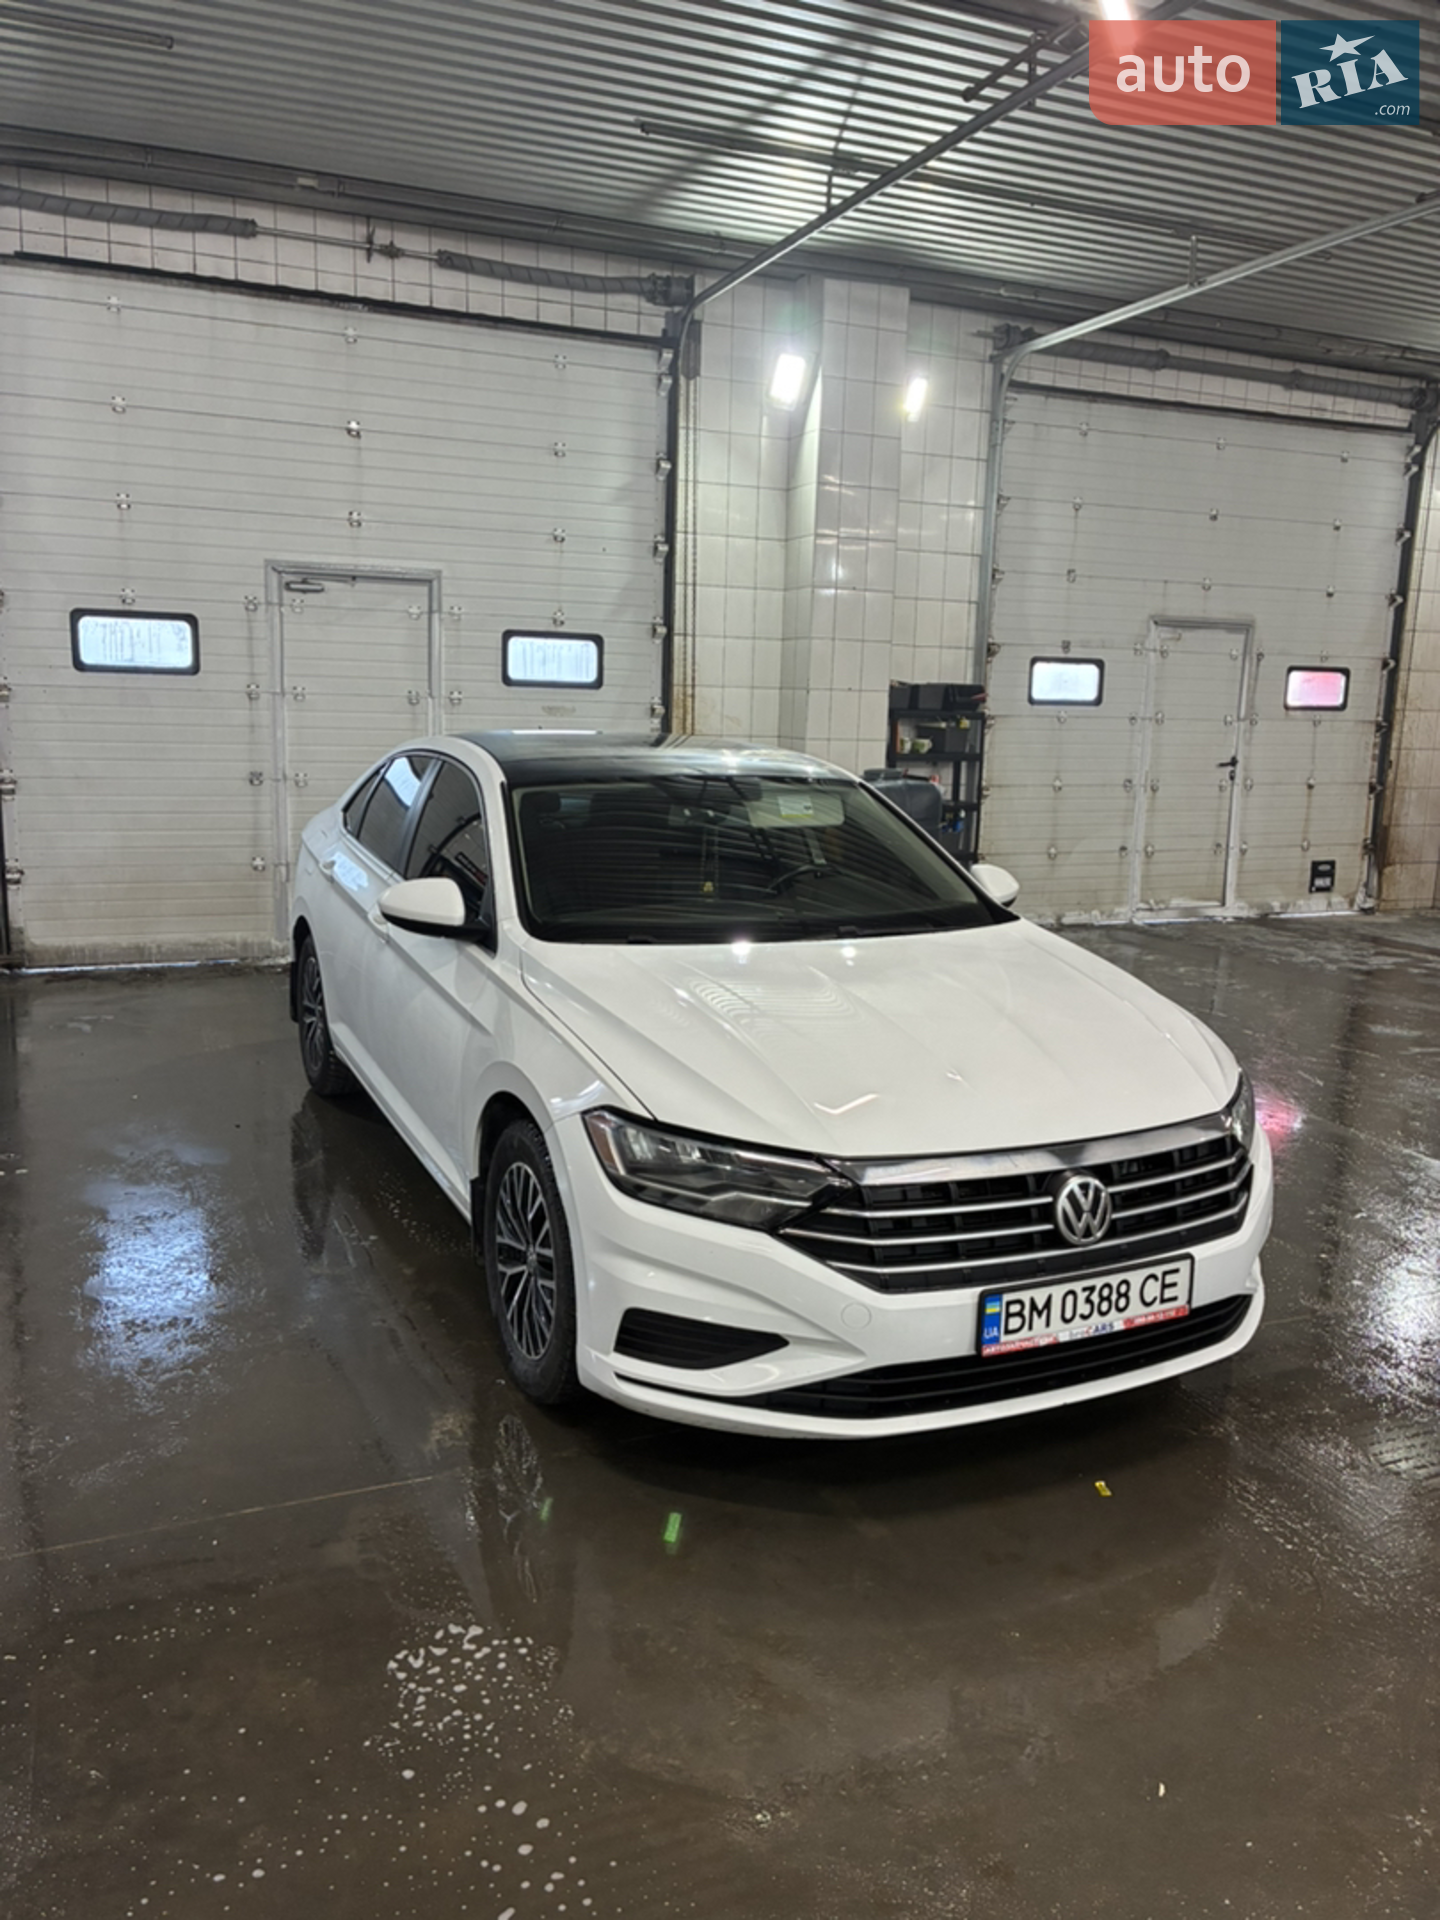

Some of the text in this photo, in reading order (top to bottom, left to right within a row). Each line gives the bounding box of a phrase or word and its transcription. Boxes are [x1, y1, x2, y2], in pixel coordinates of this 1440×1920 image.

[1003, 1293, 1052, 1335] BM
[1060, 1279, 1131, 1324] 0388
[1139, 1268, 1180, 1307] CE
[982, 1326, 999, 1339] UA
